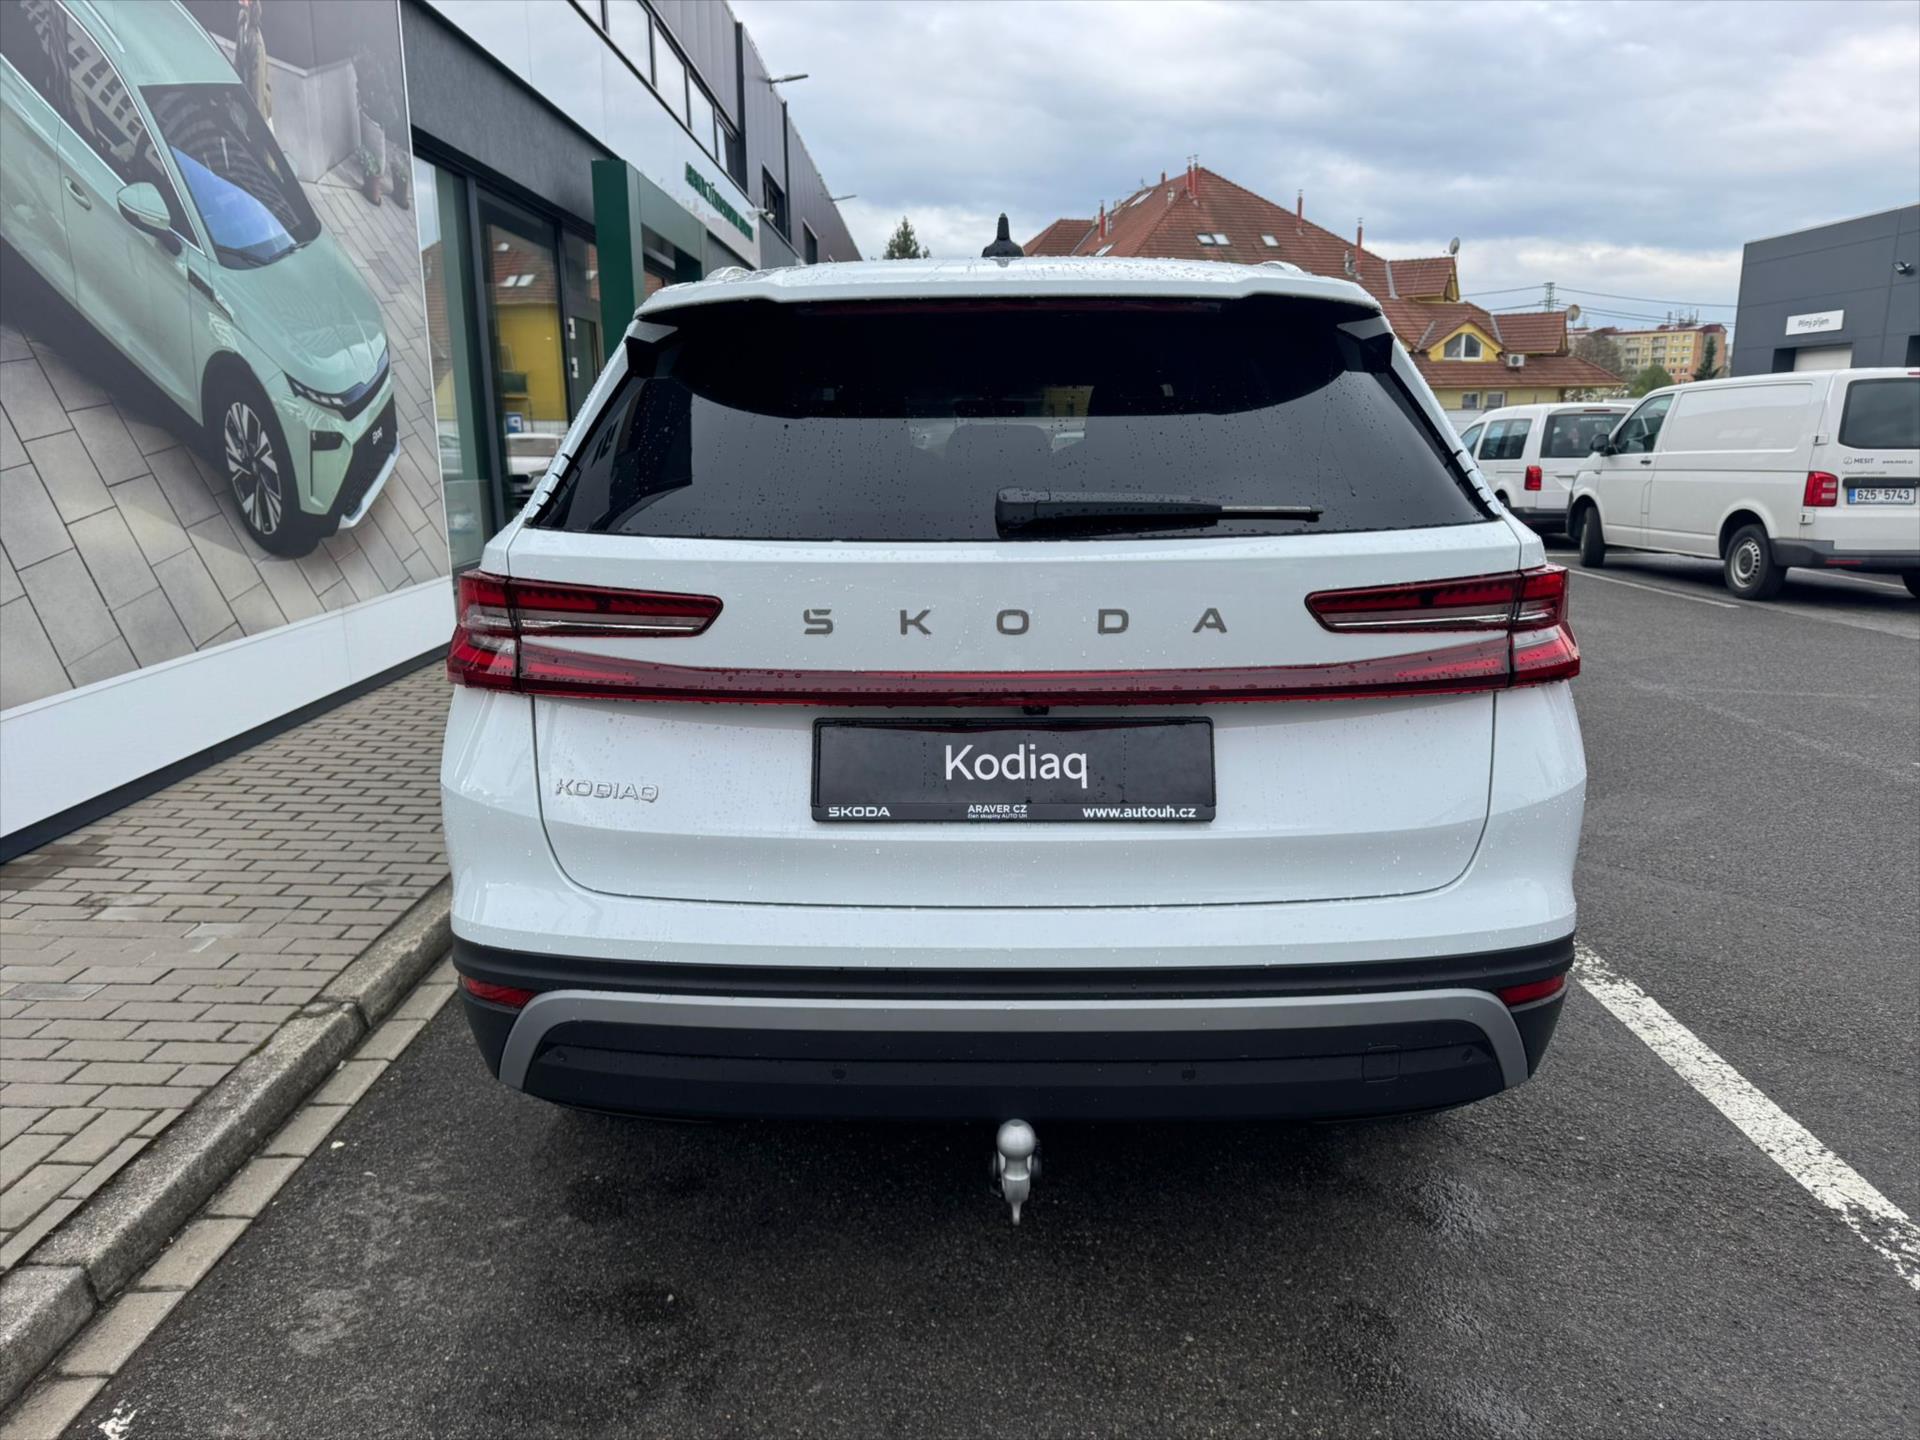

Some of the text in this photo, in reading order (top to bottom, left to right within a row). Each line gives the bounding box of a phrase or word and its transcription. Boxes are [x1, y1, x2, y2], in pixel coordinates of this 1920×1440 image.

[1853, 457, 1875, 465] MESIT
[1857, 489, 1910, 500] 6Z5 5743
[944, 743, 1089, 789] Kodiaq
[556, 779, 660, 803] KODIAQ
[967, 804, 1028, 813] ARAVER CZ
[1082, 804, 1197, 818] www.autouh.cz
